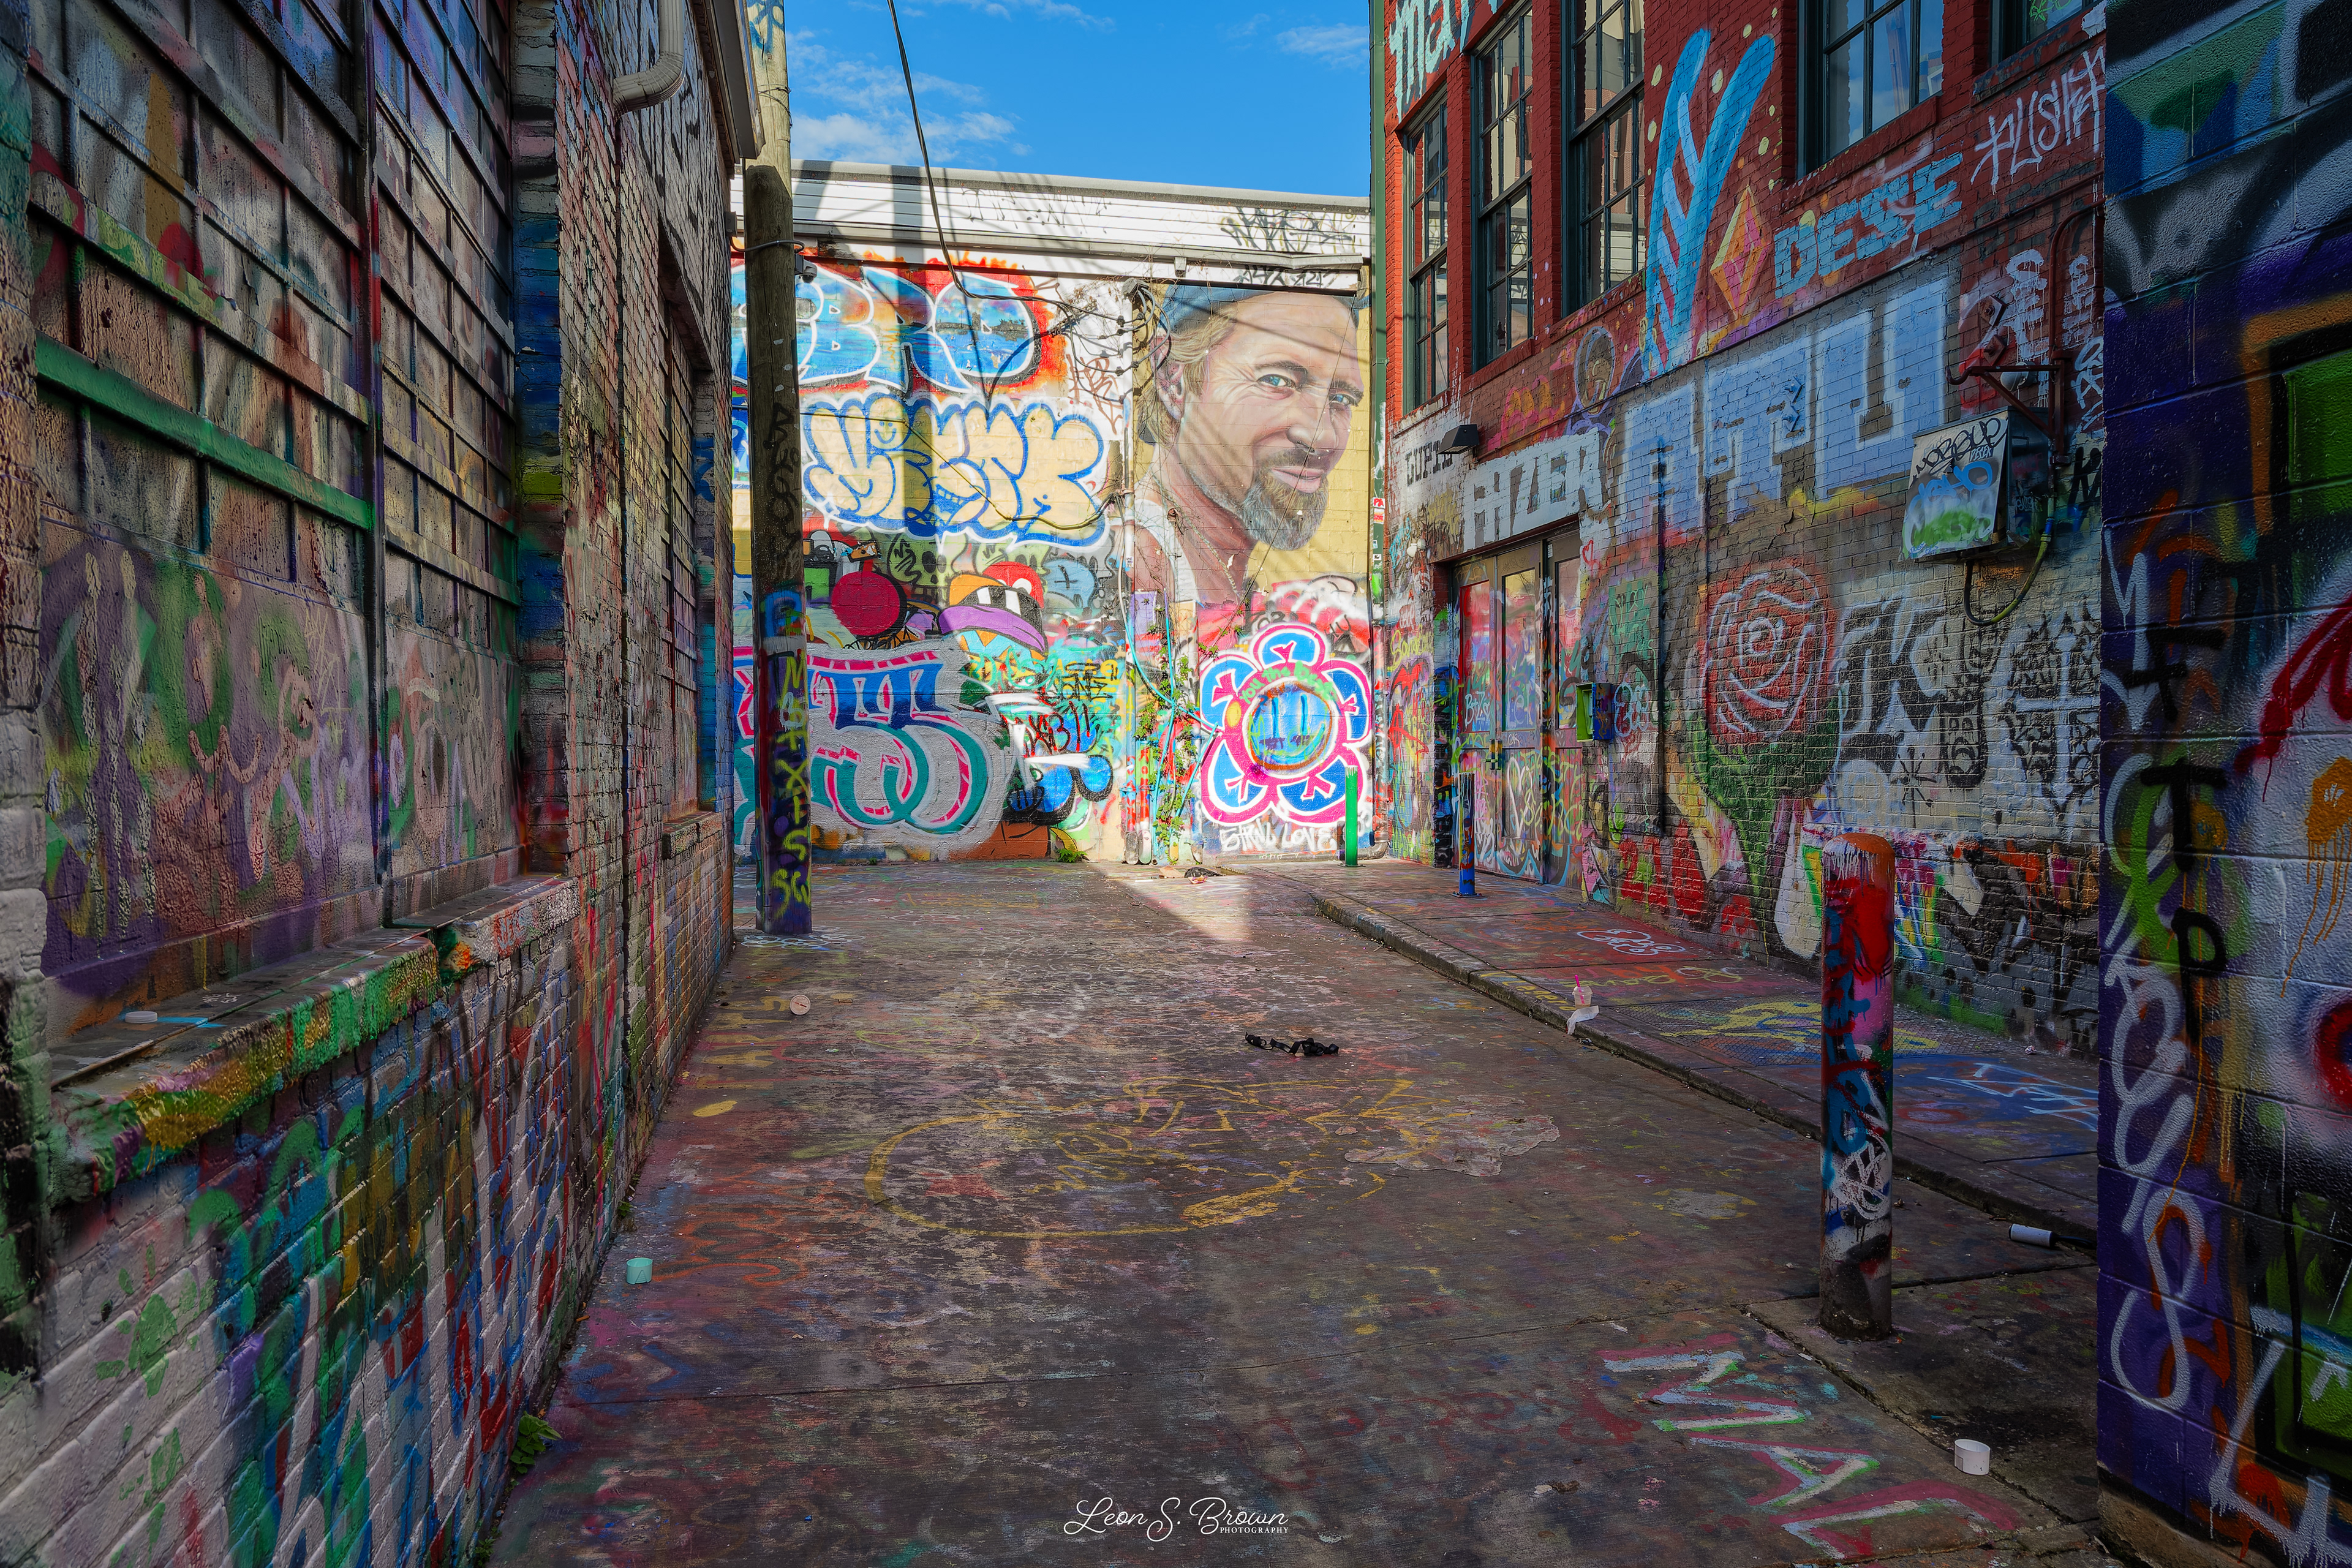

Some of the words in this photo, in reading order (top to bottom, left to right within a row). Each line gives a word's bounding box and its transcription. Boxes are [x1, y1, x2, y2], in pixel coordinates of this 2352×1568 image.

[1240, 678, 1265, 704] you
[1262, 667, 1291, 682] the
[1281, 823, 1338, 852] LOVE
